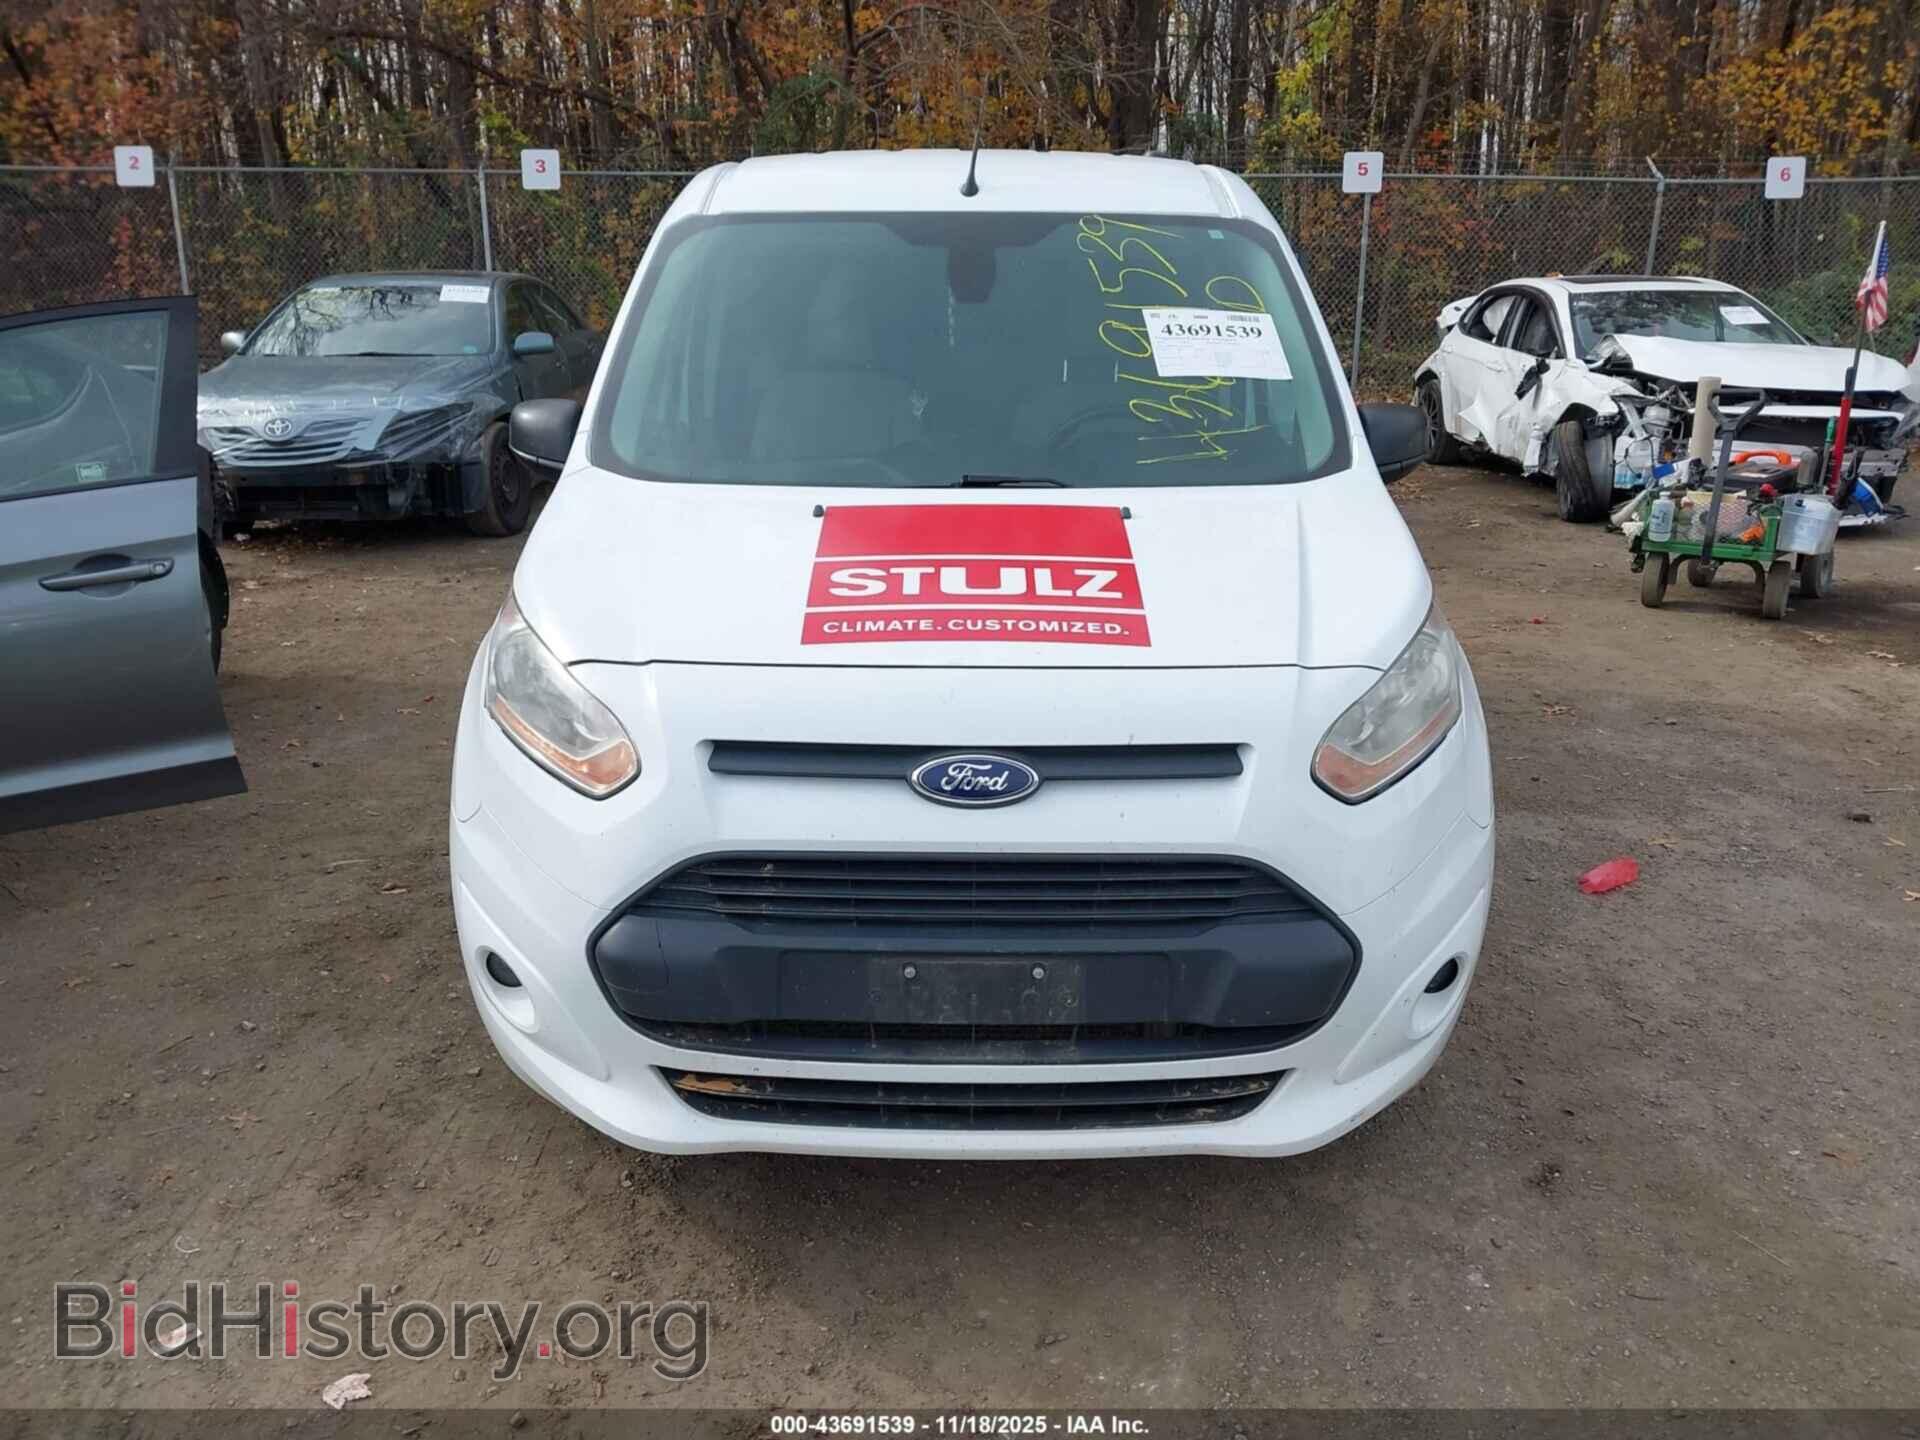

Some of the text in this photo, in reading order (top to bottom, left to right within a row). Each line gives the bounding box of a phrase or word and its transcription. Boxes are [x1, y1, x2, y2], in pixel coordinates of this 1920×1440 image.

[128, 156, 140, 170] 2
[535, 160, 546, 173] 3
[1358, 162, 1369, 176] 5
[1780, 167, 1791, 182] 6
[1161, 323, 1262, 338] 43691539
[828, 566, 1124, 599] STULZ
[822, 618, 1130, 636] CLIMATE. CUSTOMIZED.
[940, 762, 1010, 791] Ford
